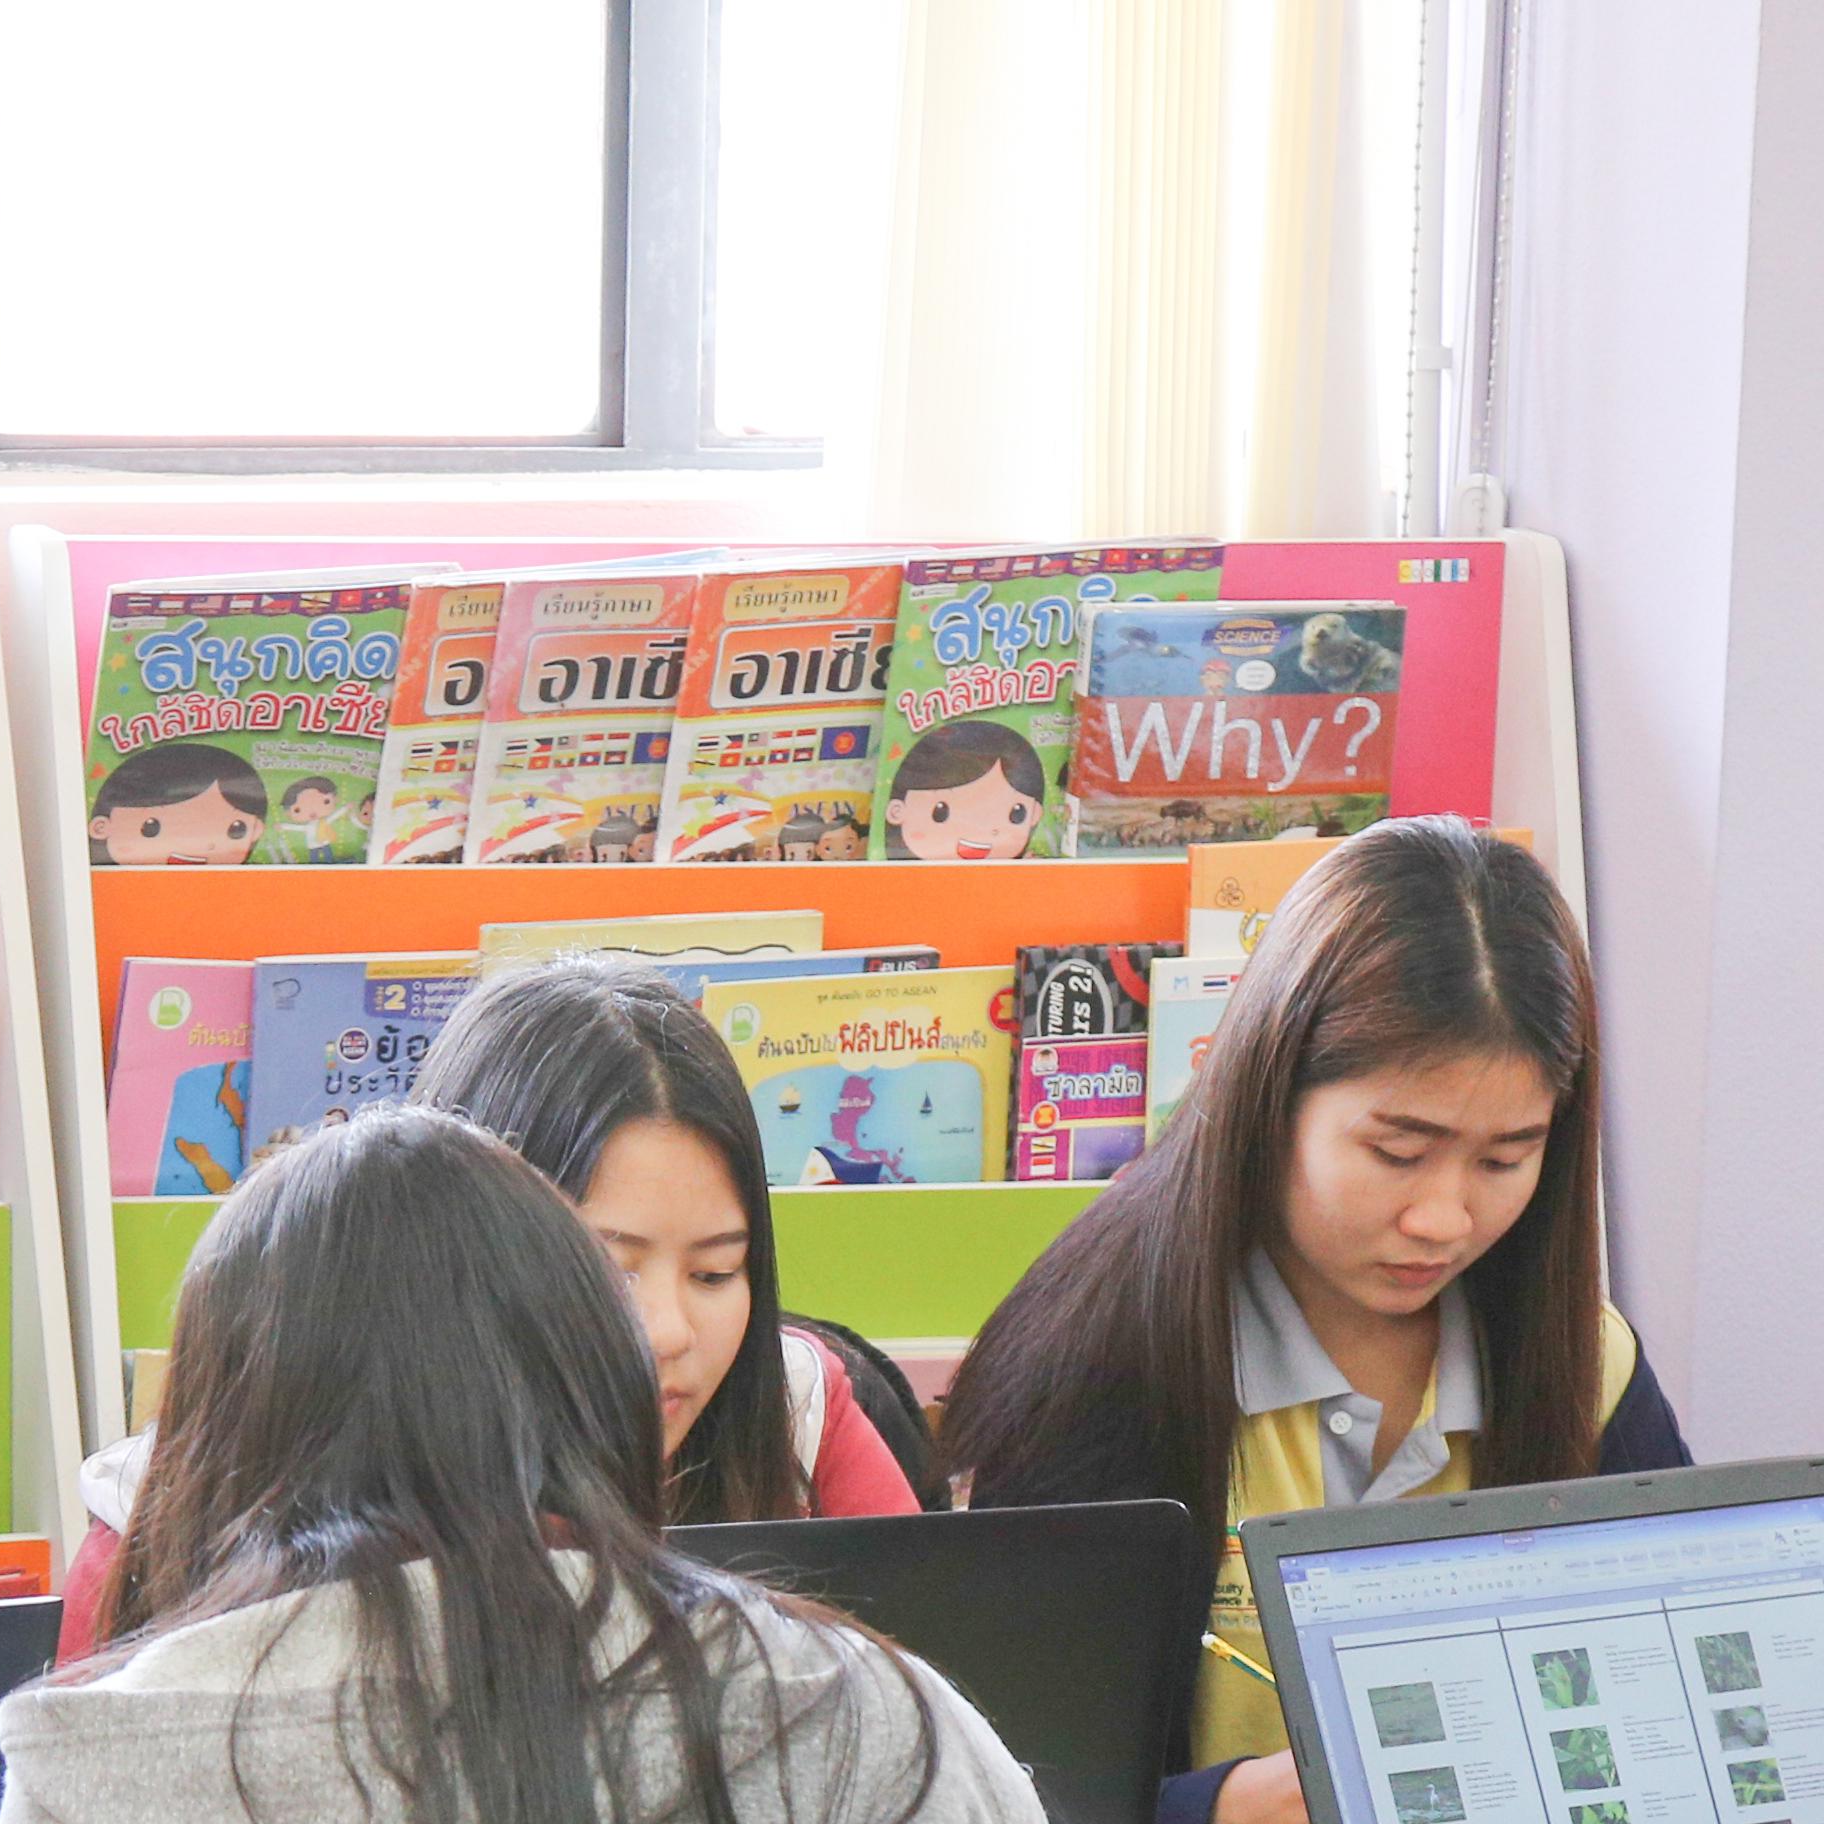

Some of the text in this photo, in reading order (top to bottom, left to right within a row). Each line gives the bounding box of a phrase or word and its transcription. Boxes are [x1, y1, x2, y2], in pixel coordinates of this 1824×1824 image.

[1212, 628, 1282, 646] SCIENCE
[135, 617, 401, 696] สนุกคิด
[1106, 696, 1381, 793] Why?
[1068, 963, 1094, 994] 2!
[384, 984, 407, 1011] 2
[1072, 1001, 1092, 1037] rs
